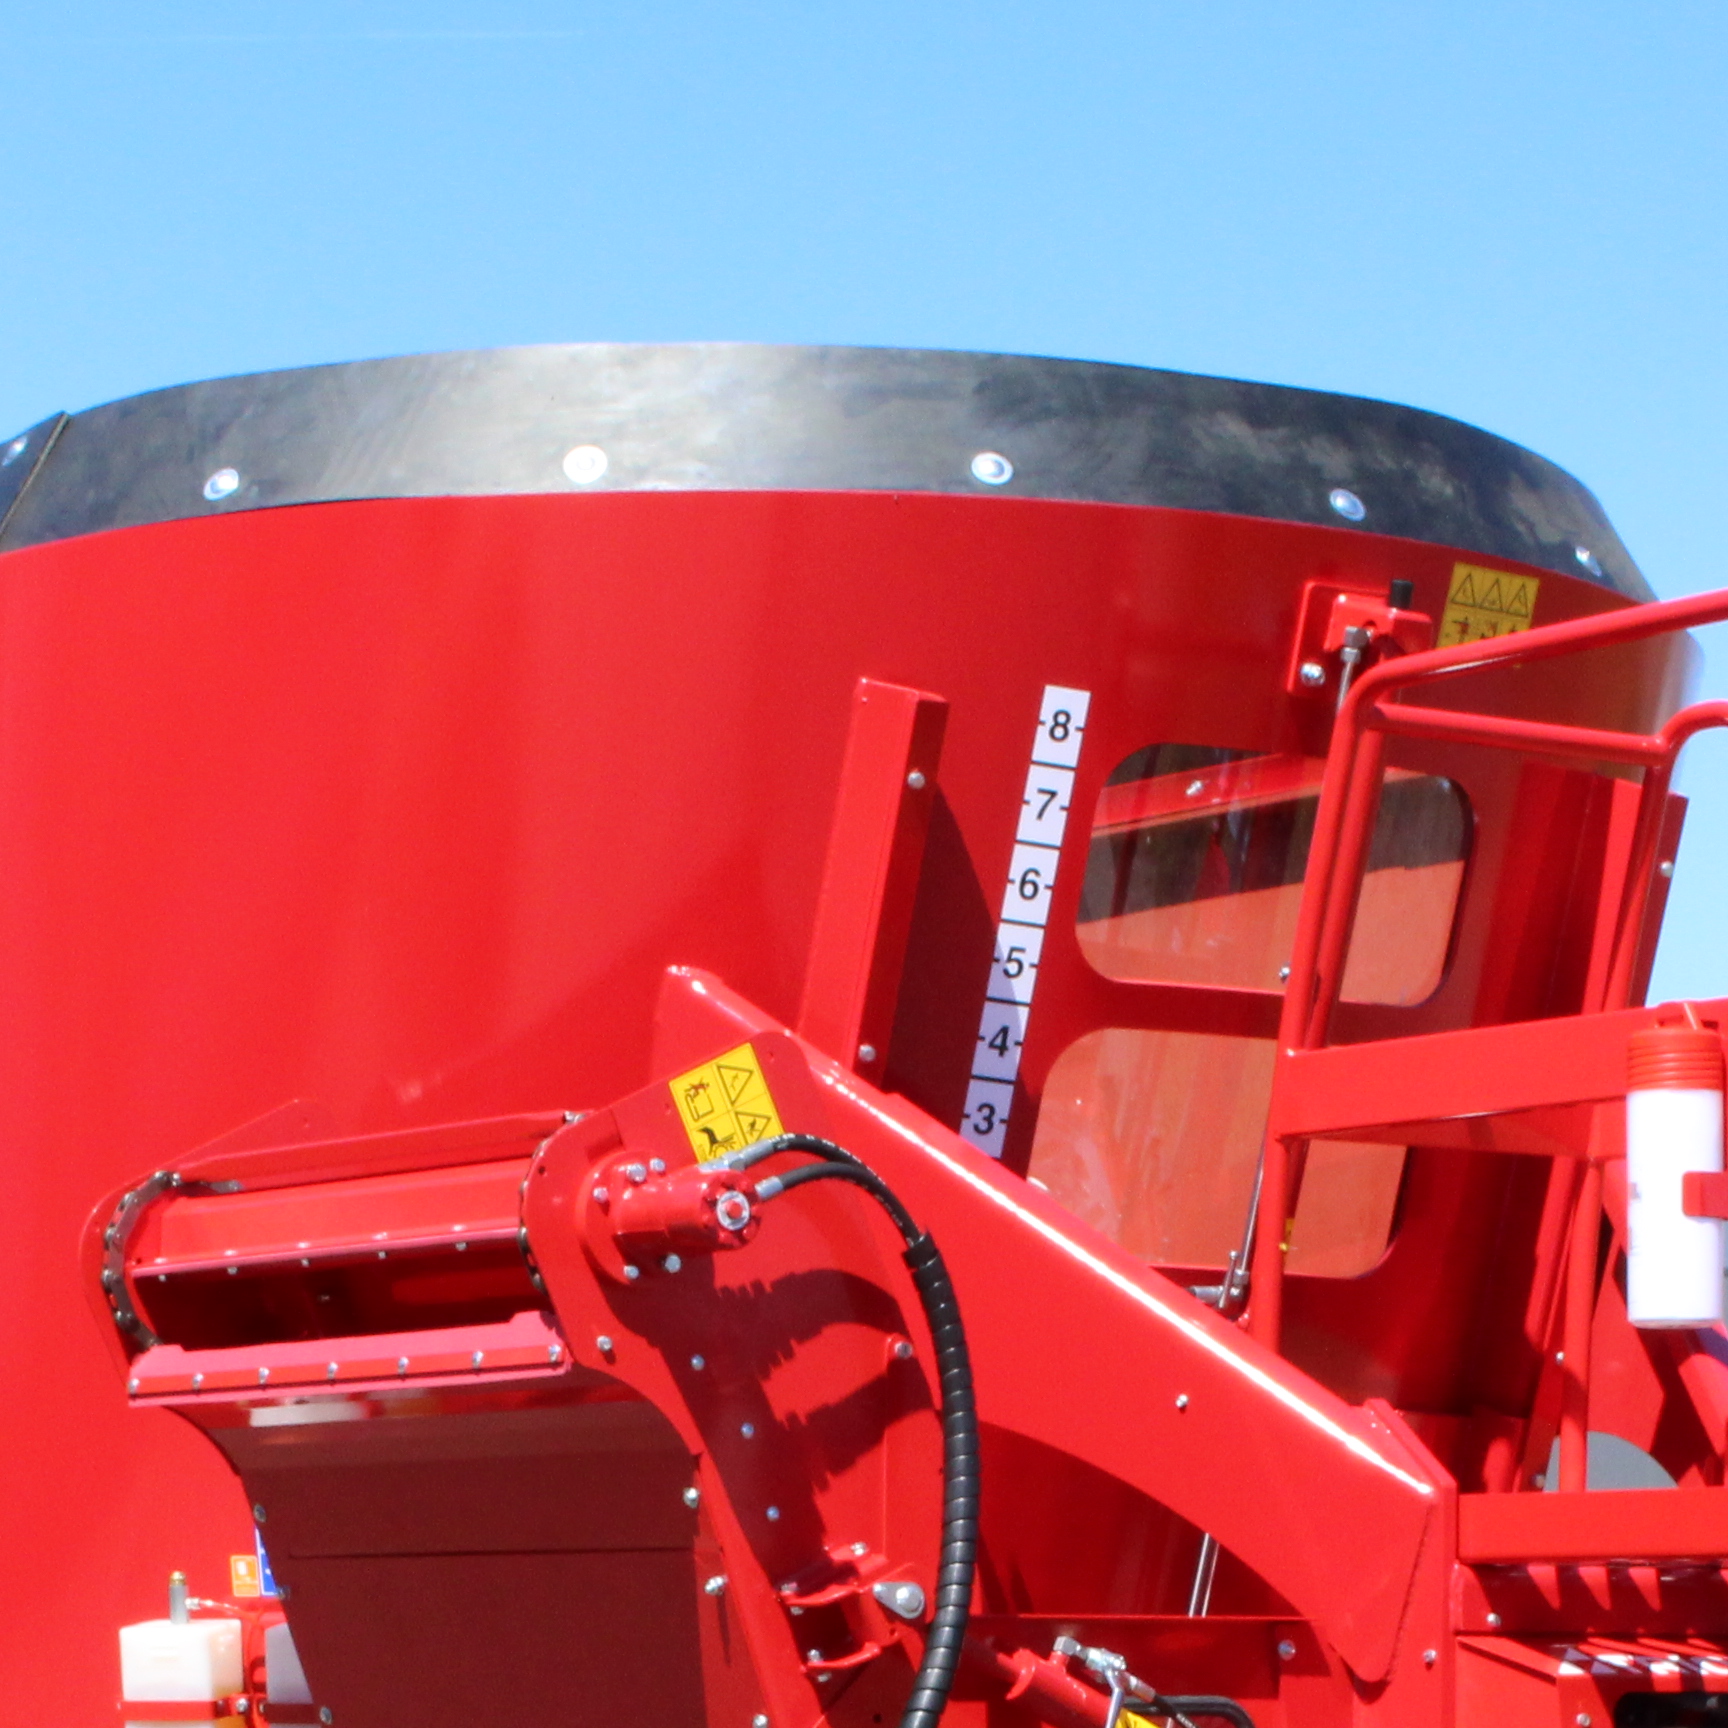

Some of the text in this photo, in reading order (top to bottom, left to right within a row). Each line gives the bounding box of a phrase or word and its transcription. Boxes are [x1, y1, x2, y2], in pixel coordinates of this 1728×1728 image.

[1048, 709, 1072, 742] 8
[1036, 787, 1059, 821] 7
[1018, 867, 1041, 901] 6
[1002, 946, 1027, 979] 5
[988, 1025, 1010, 1058] 4
[972, 1103, 996, 1136] 3
